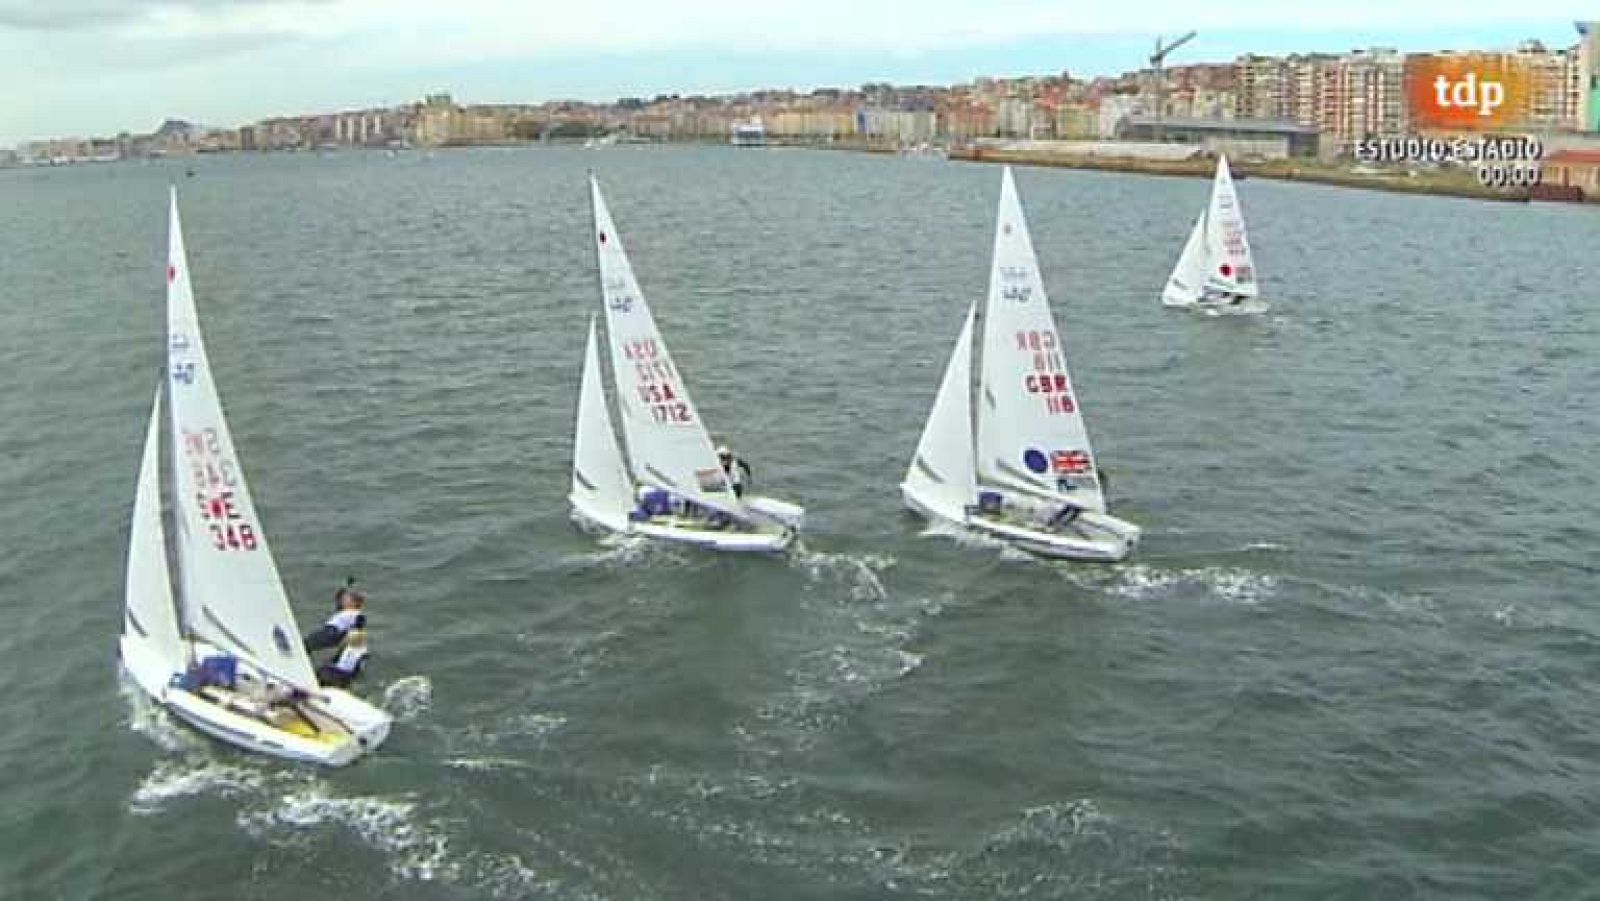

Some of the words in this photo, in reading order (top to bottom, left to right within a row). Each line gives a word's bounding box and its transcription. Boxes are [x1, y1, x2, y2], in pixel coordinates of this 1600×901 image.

[637, 384, 675, 403] USA
[1026, 375, 1067, 393] GBR
[650, 403, 693, 423] 1712
[1047, 395, 1075, 414] 118
[209, 524, 257, 551] 348
